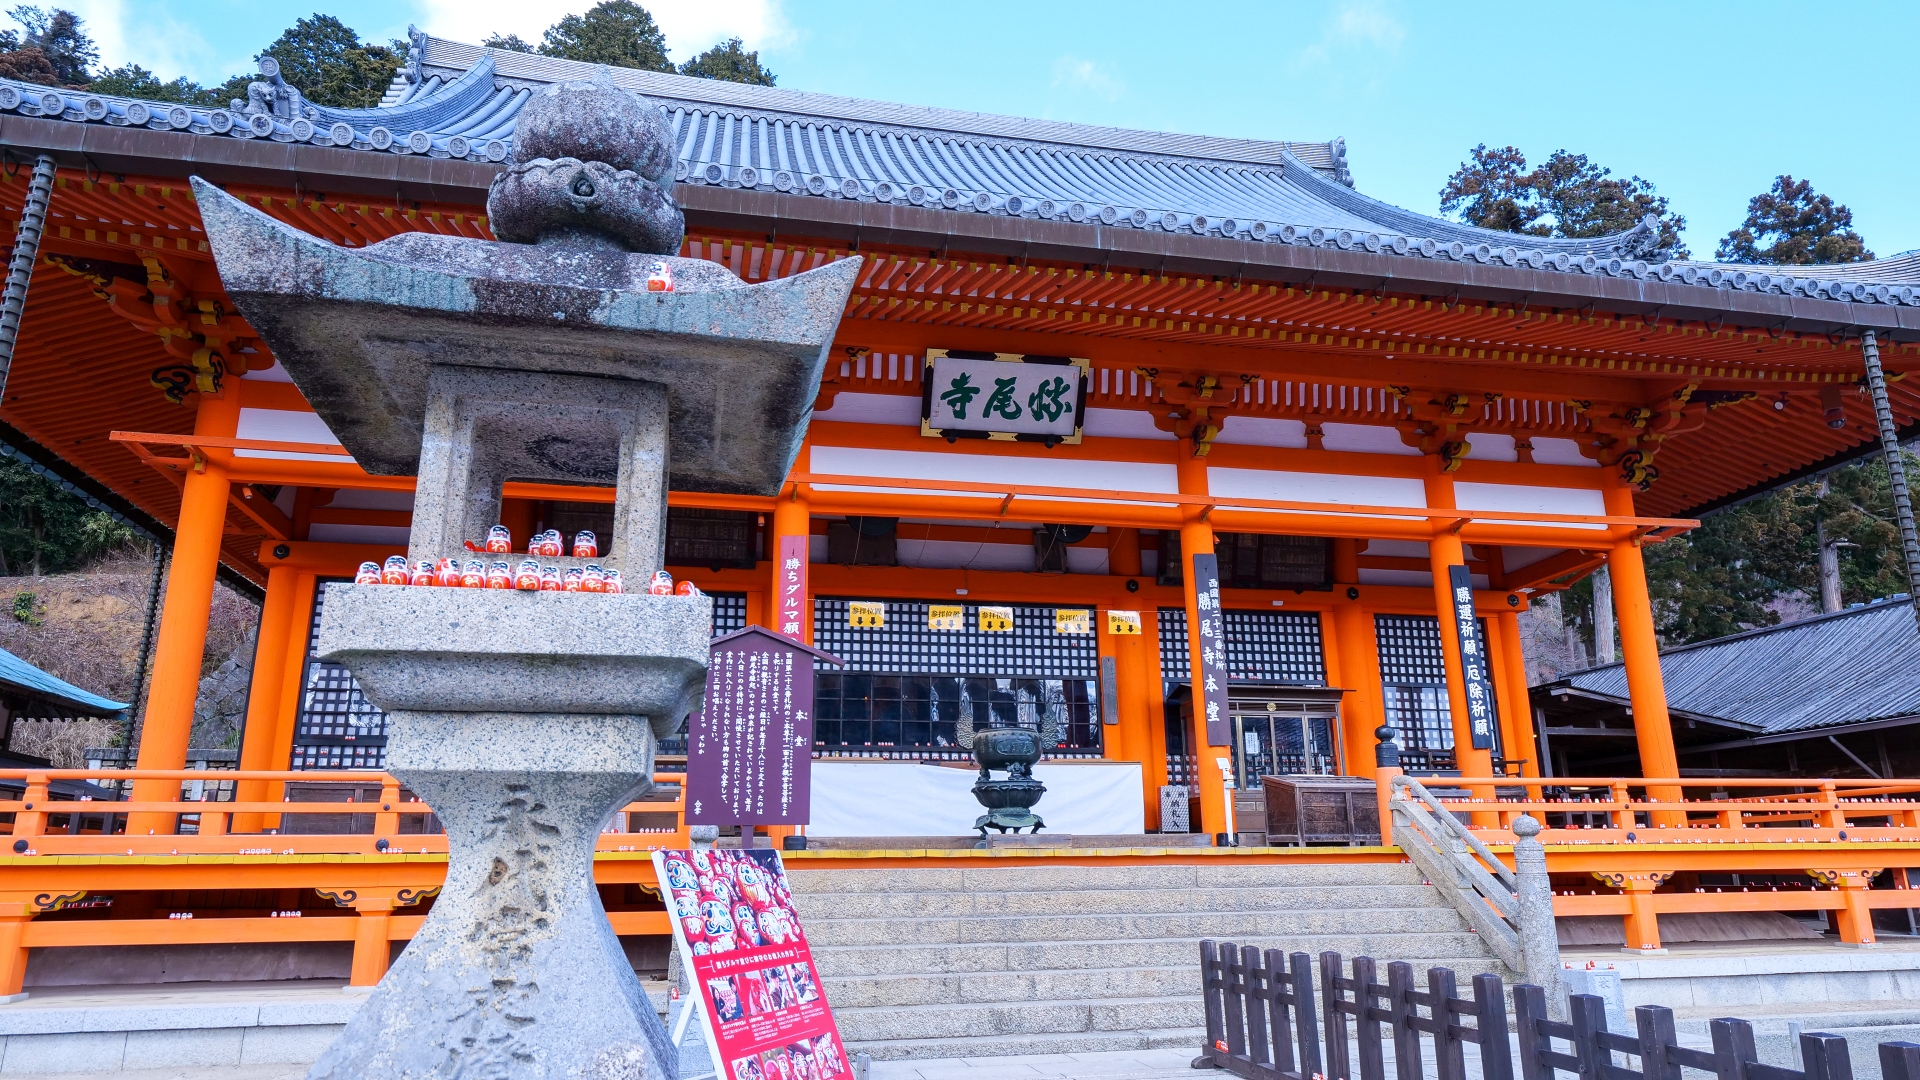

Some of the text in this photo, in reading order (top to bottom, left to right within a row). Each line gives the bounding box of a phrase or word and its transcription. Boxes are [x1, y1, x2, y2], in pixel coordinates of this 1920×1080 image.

[940, 372, 1073, 423] 勝尾寺
[783, 557, 802, 642] 勝ちダルマ願
[852, 607, 882, 615] 参拝位置
[931, 610, 960, 618] 参拝位置
[981, 611, 1010, 619] 参拝位置
[1058, 614, 1086, 622] 参拝位置
[1208, 578, 1224, 671] 西国第二十三番札所
[1198, 592, 1220, 722] 勝尾寺本堂
[1456, 587, 1489, 736] 勝運祈願・厄除祈願
